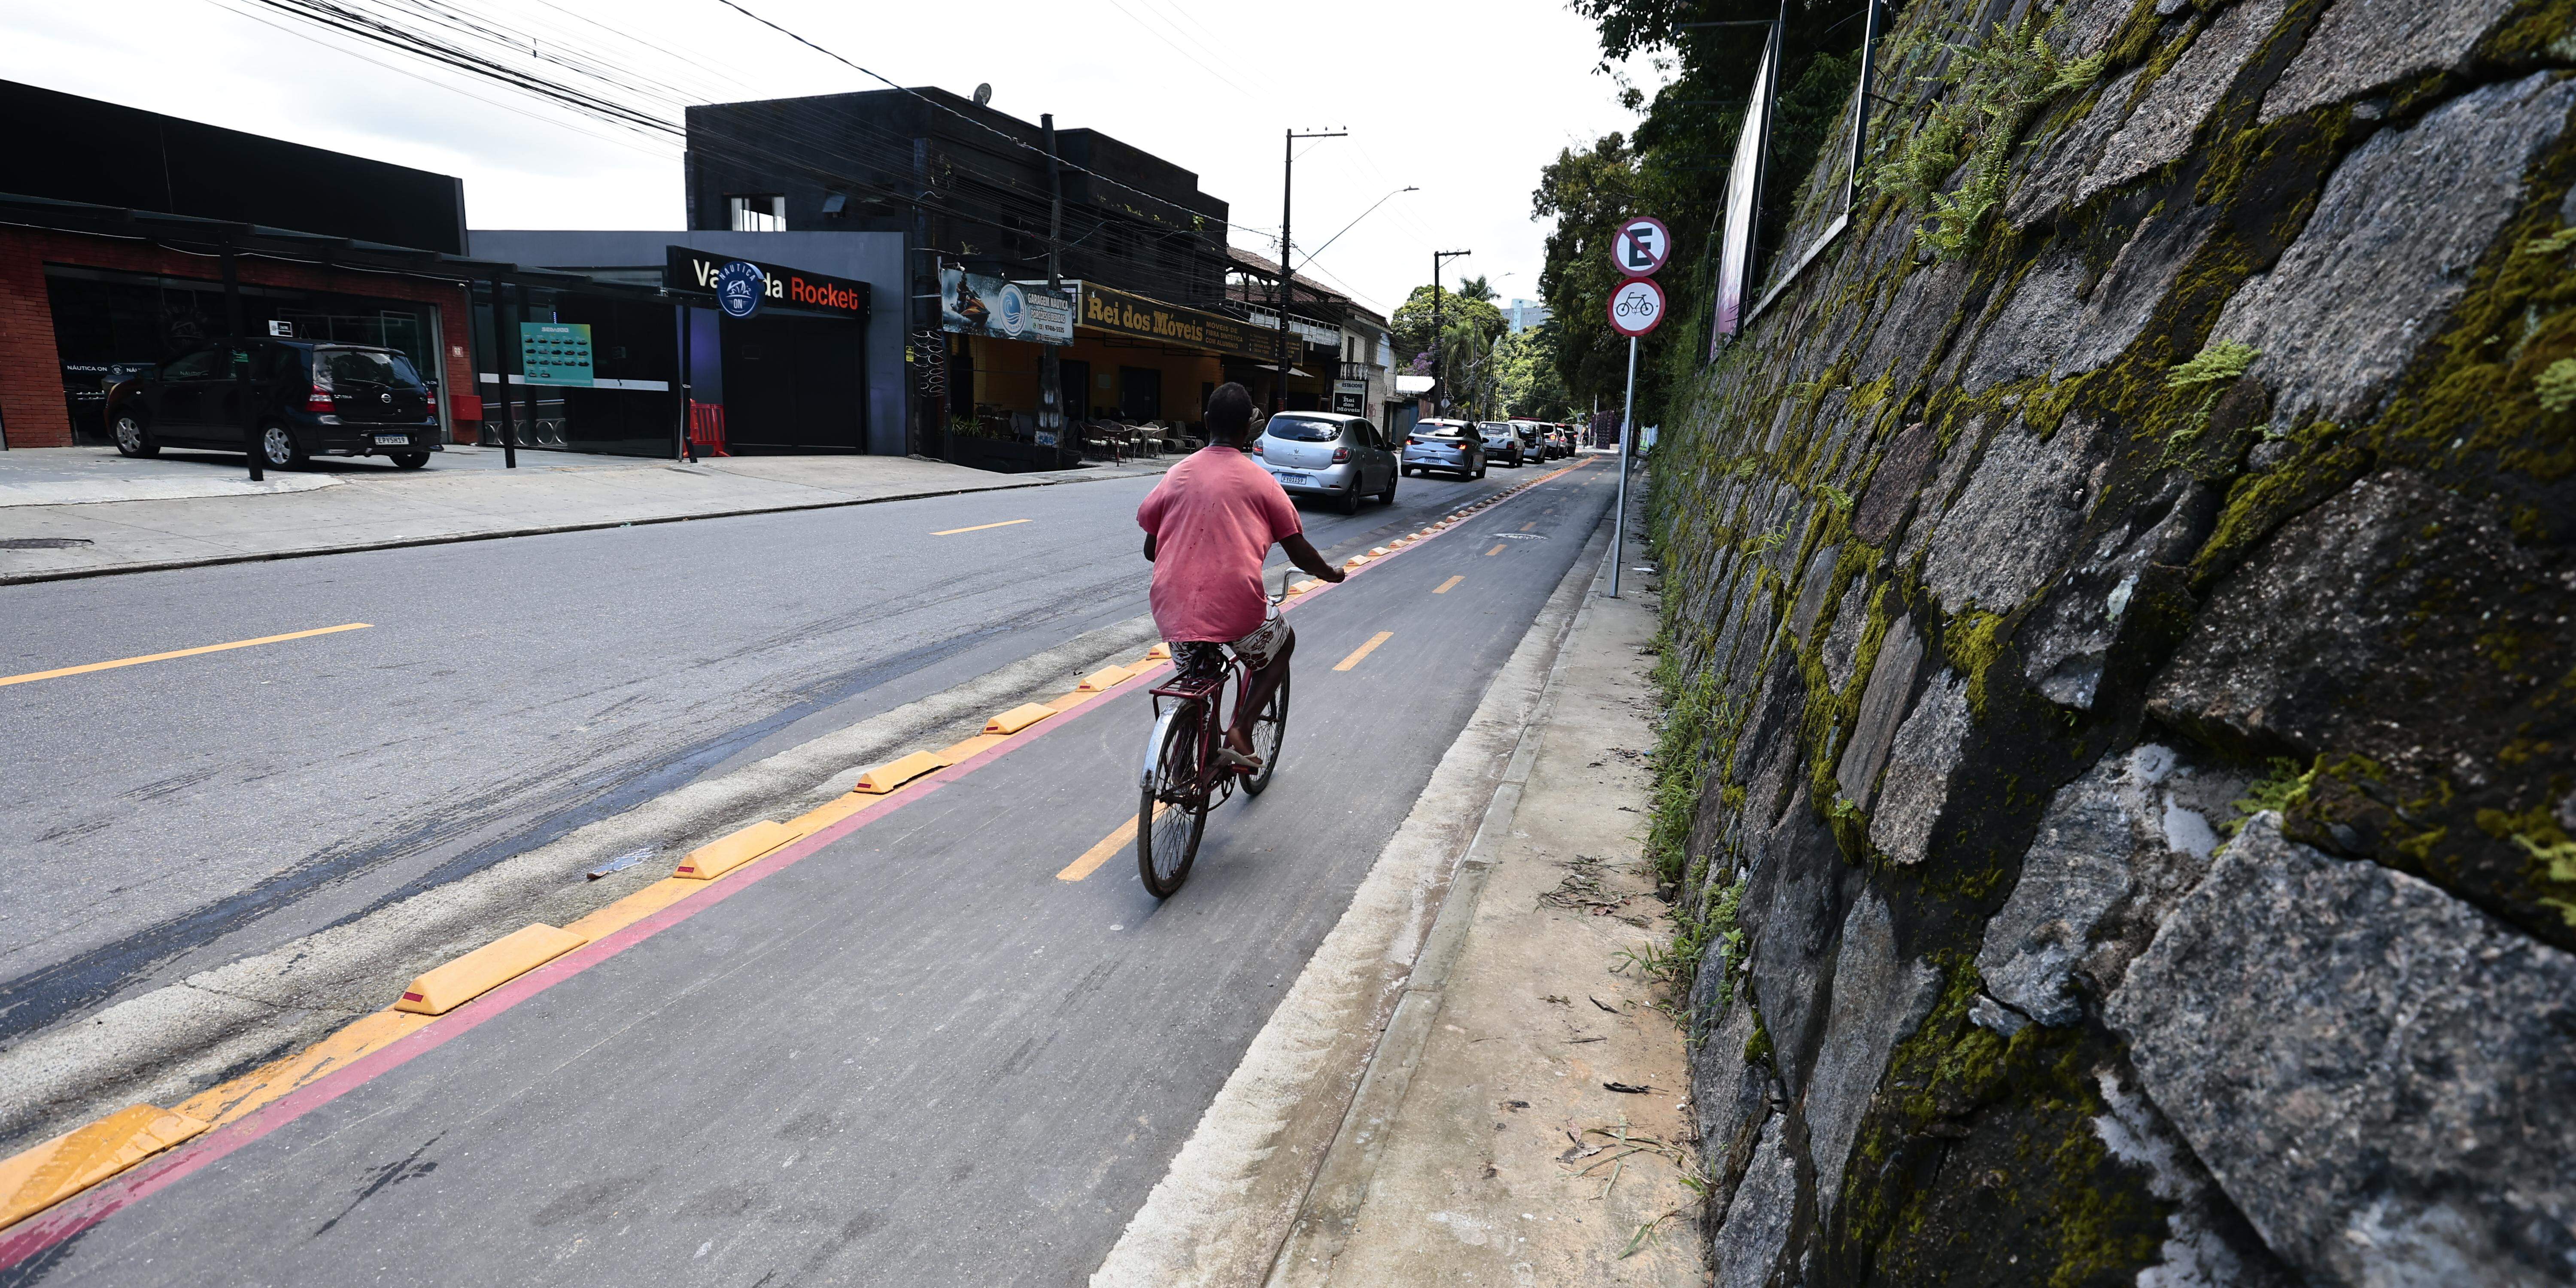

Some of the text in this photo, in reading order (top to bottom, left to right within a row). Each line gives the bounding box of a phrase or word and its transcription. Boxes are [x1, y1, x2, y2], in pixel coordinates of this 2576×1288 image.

[1628, 228, 1653, 267] E
[693, 259, 858, 310] Vada Rocket
[733, 298, 742, 309] ON
[1028, 293, 1049, 307] GARAGEM
[1050, 296, 1068, 310] NÁUTICA
[1031, 308, 1065, 323] PORÇÕES E BEBIDAS
[1088, 297, 1120, 325] Rei
[1123, 305, 1150, 331] dos
[1153, 311, 1203, 341] Móveis
[1045, 325, 1064, 333] 97416-5535
[1206, 322, 1228, 331] MÓVEIS
[1206, 329, 1219, 337] FIBRA
